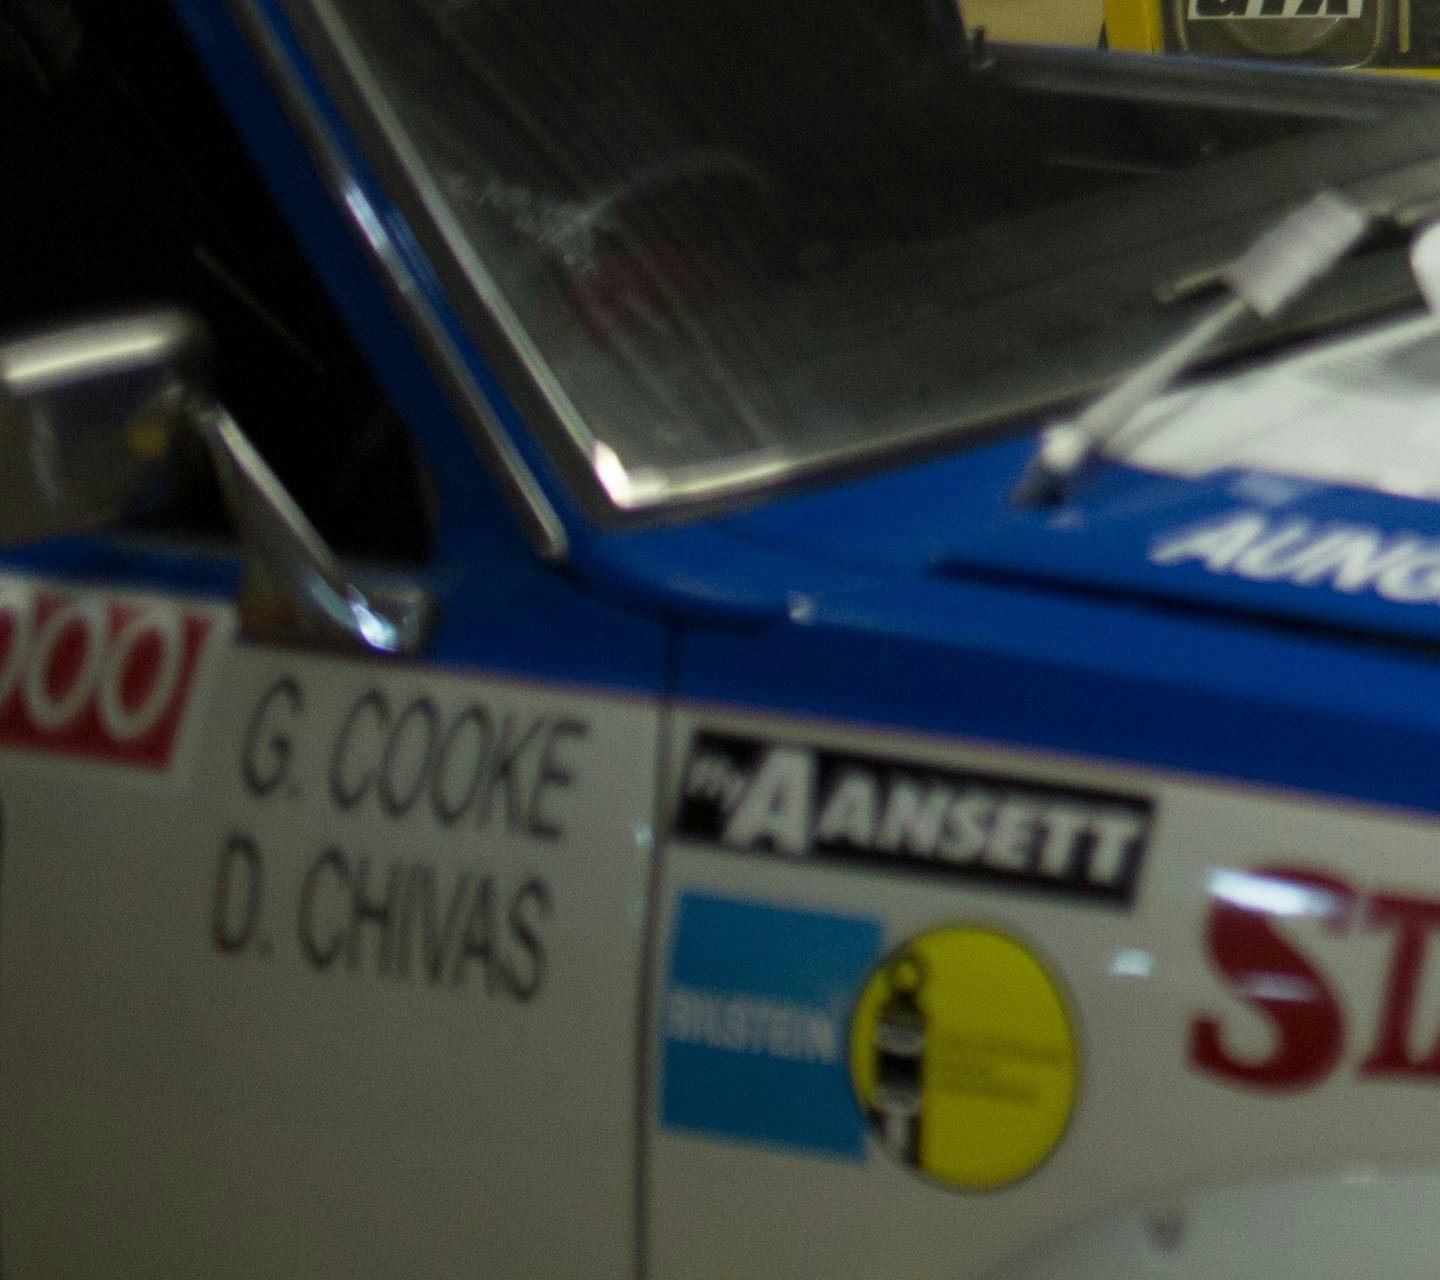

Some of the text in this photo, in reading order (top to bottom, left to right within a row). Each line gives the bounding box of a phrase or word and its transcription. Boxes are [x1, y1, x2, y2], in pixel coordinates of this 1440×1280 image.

[242, 675, 590, 846] G. COOKE
[211, 838, 554, 1006] D. CHIVAS
